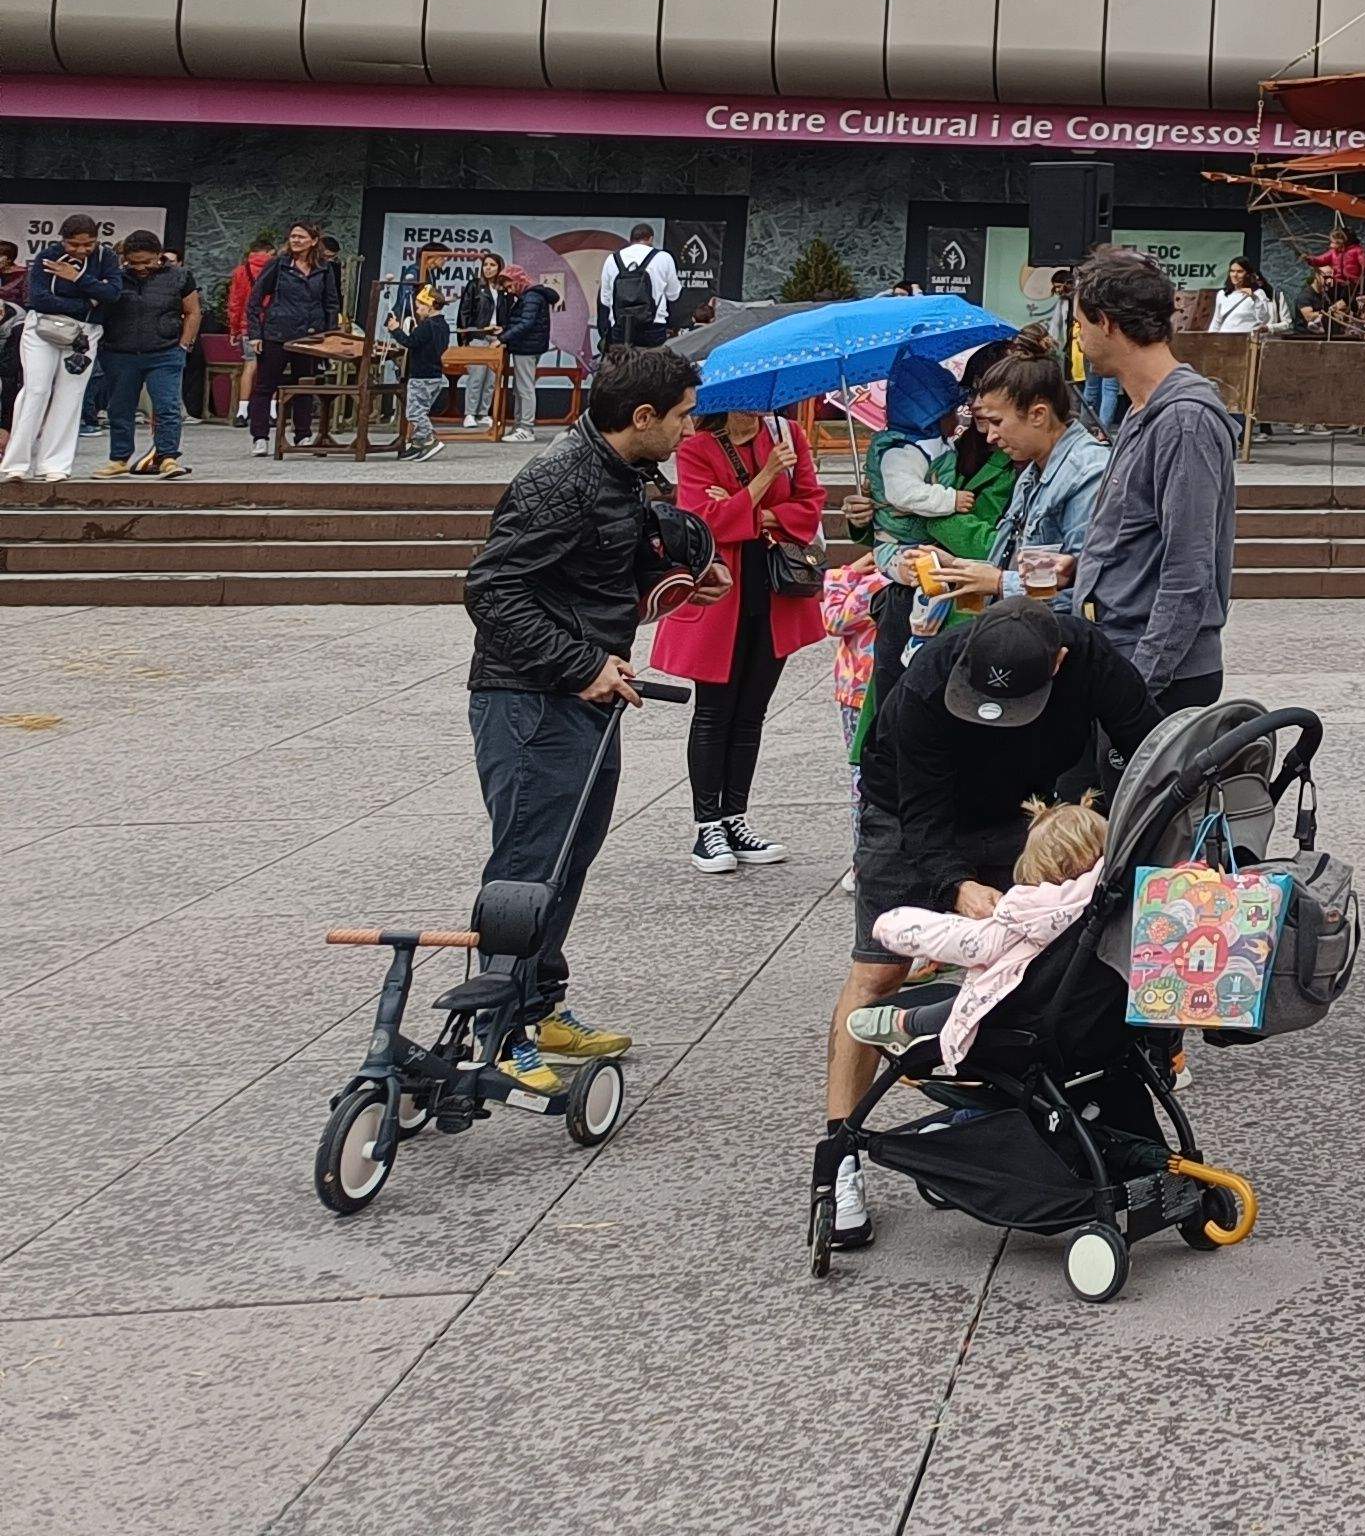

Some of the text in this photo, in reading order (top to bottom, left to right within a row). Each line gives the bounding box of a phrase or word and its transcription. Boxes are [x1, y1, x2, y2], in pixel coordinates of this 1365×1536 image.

[705, 105, 826, 133] Centre
[839, 110, 978, 138] Cultural
[990, 115, 1000, 138] i
[1011, 115, 1053, 138] de
[1066, 116, 1259, 149] Congressos
[28, 220, 54, 235] 30
[403, 227, 494, 244] REPASSA
